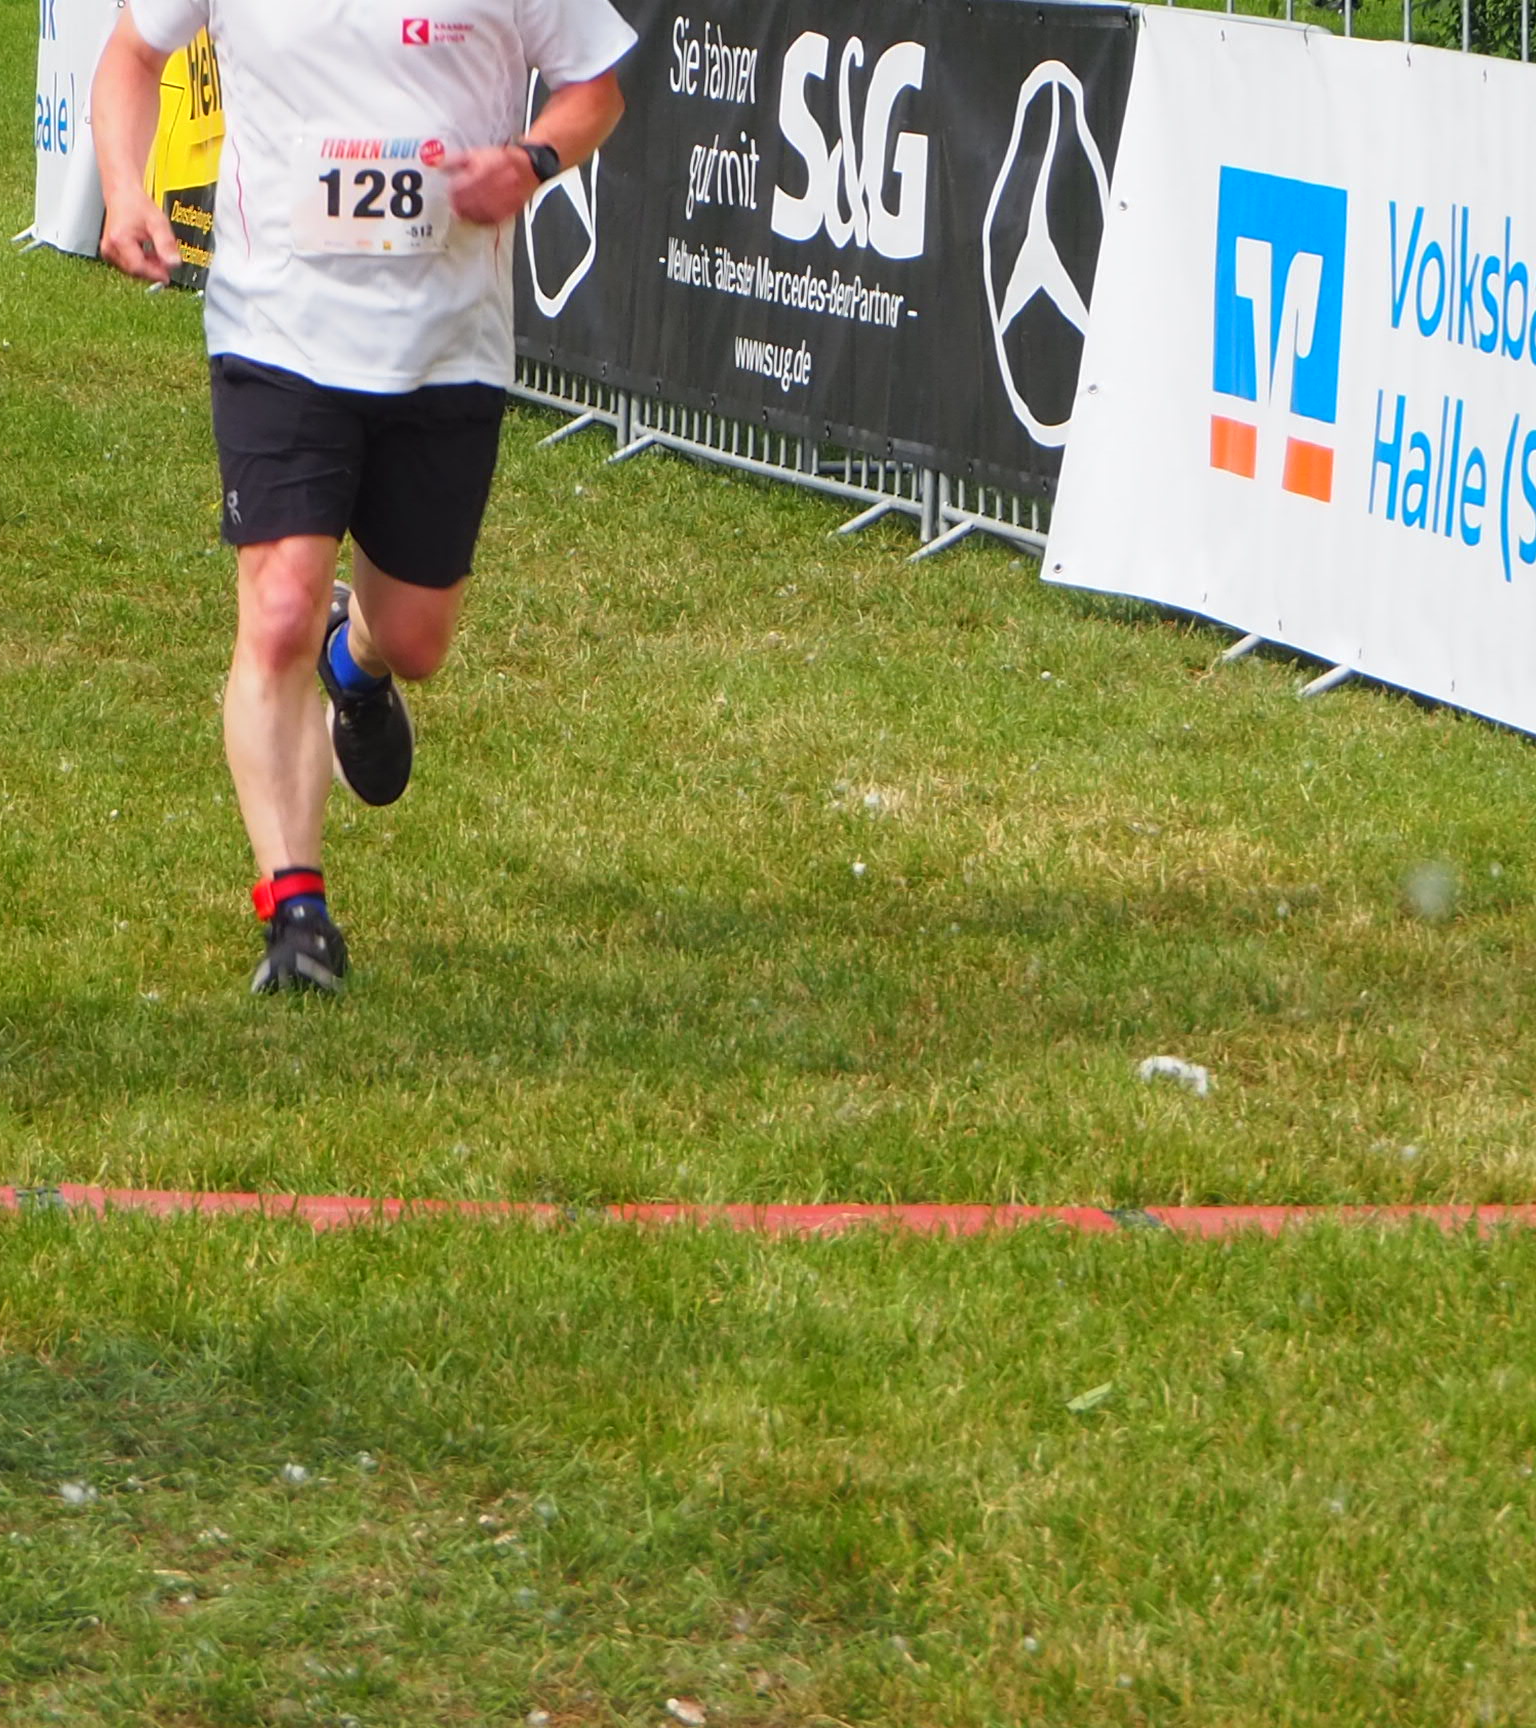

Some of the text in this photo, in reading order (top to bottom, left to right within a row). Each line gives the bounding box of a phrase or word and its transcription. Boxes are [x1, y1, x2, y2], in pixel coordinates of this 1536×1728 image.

[669, 16, 759, 105] Sie fahren
[685, 131, 760, 221] gut mit
[770, 30, 929, 259] S&G
[319, 168, 424, 219] 128
[667, 236, 712, 288] Weltweit
[1368, 388, 1488, 546] Halle
